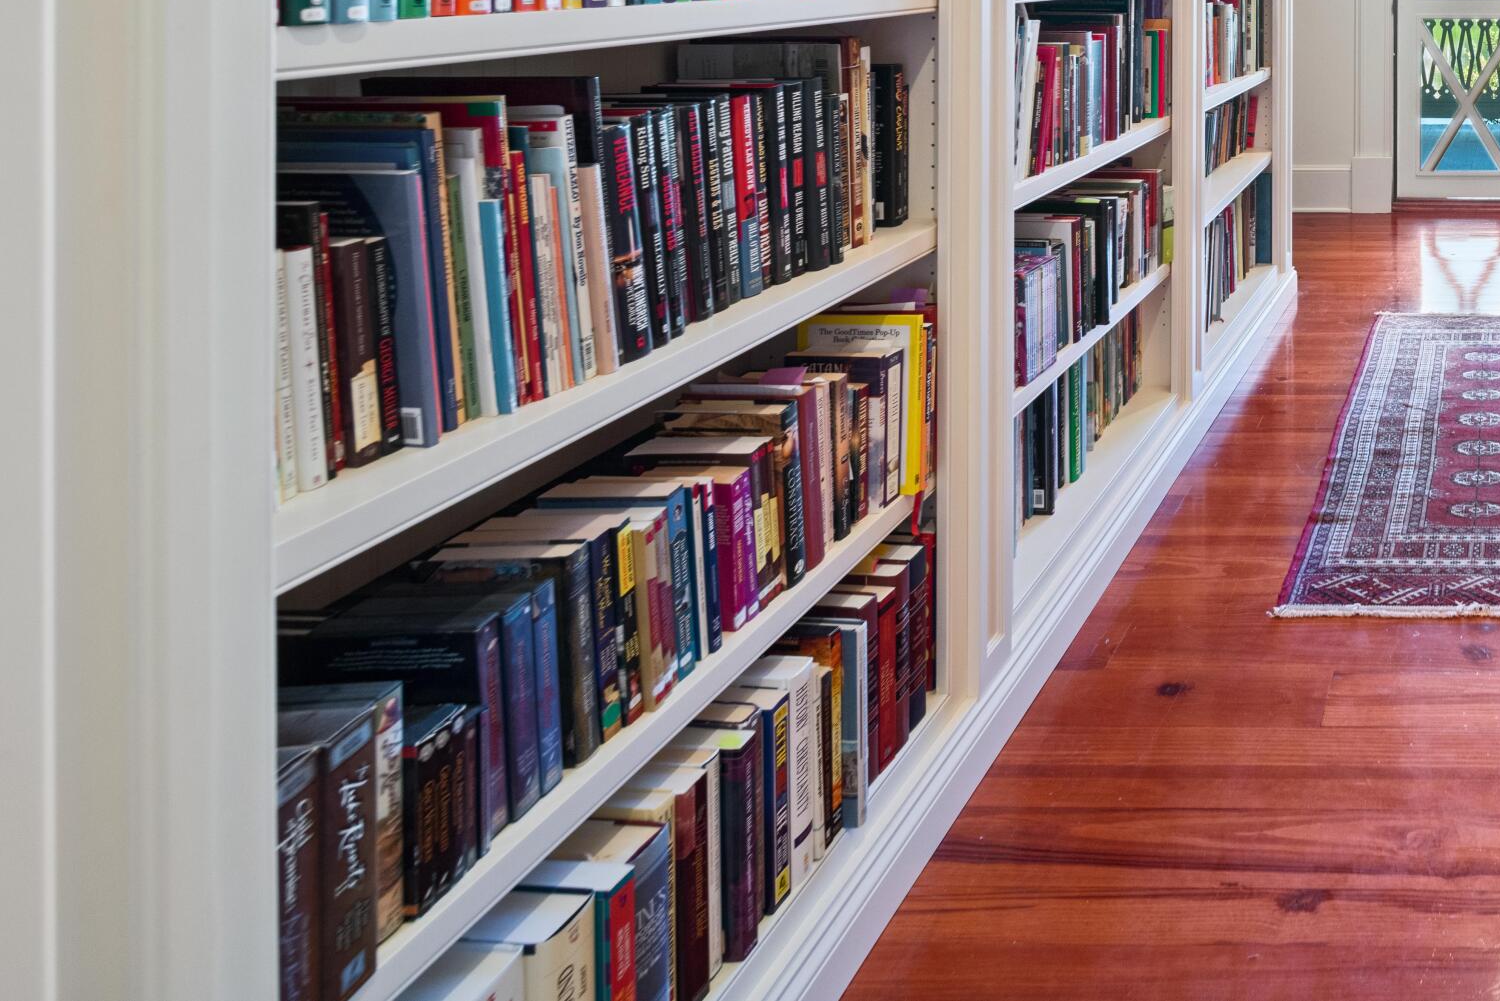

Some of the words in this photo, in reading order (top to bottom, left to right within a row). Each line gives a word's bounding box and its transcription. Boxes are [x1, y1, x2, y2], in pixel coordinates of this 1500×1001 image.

[719, 101, 733, 138] Killing
[776, 91, 785, 123] KILLING
[792, 90, 804, 122] KILLING
[814, 90, 824, 118] KILLING
[565, 117, 576, 162] CITIZEN
[743, 102, 753, 146] KENNEDY'S
[778, 125, 786, 142] THE
[793, 123, 804, 154] REAGAN
[815, 119, 825, 149] LINCOLN
[636, 125, 647, 166] Rising
[642, 167, 651, 190] Sun
[723, 139, 734, 176] Patton
[746, 147, 754, 169] LAST
[779, 143, 787, 161] MOB
[516, 161, 526, 183] 100
[569, 164, 580, 203] LAZLO!
[613, 136, 635, 214] VENGEANCE
[747, 169, 756, 190] DAYS
[517, 184, 530, 224] WOMEN
[794, 190, 804, 207] BILL
[819, 187, 827, 202] BILL
[573, 215, 582, 230] By
[728, 212, 737, 232] BILL
[758, 199, 769, 222] BILL
[795, 207, 804, 235] O'REILLY
[820, 202, 829, 228] O'REILLY
[575, 230, 583, 250] Don
[748, 221, 758, 242] BILL
[760, 223, 772, 269] O'REILLY
[375, 247, 386, 263] THE
[729, 232, 740, 263] O'REILLY
[749, 242, 760, 273] O'REILLY
[576, 251, 588, 288] Novello
[376, 264, 390, 324] AUTOBIOGRAPHY
[381, 325, 392, 336] OF
[819, 328, 833, 336] The
[834, 327, 874, 336] GoodTimes
[875, 328, 901, 337] Pop-Up
[380, 337, 397, 385] GEORGE
[787, 466, 799, 552] CONSPIRACY
[796, 682, 809, 734] HISTORY
[796, 737, 810, 818] CHRISTIANITY
